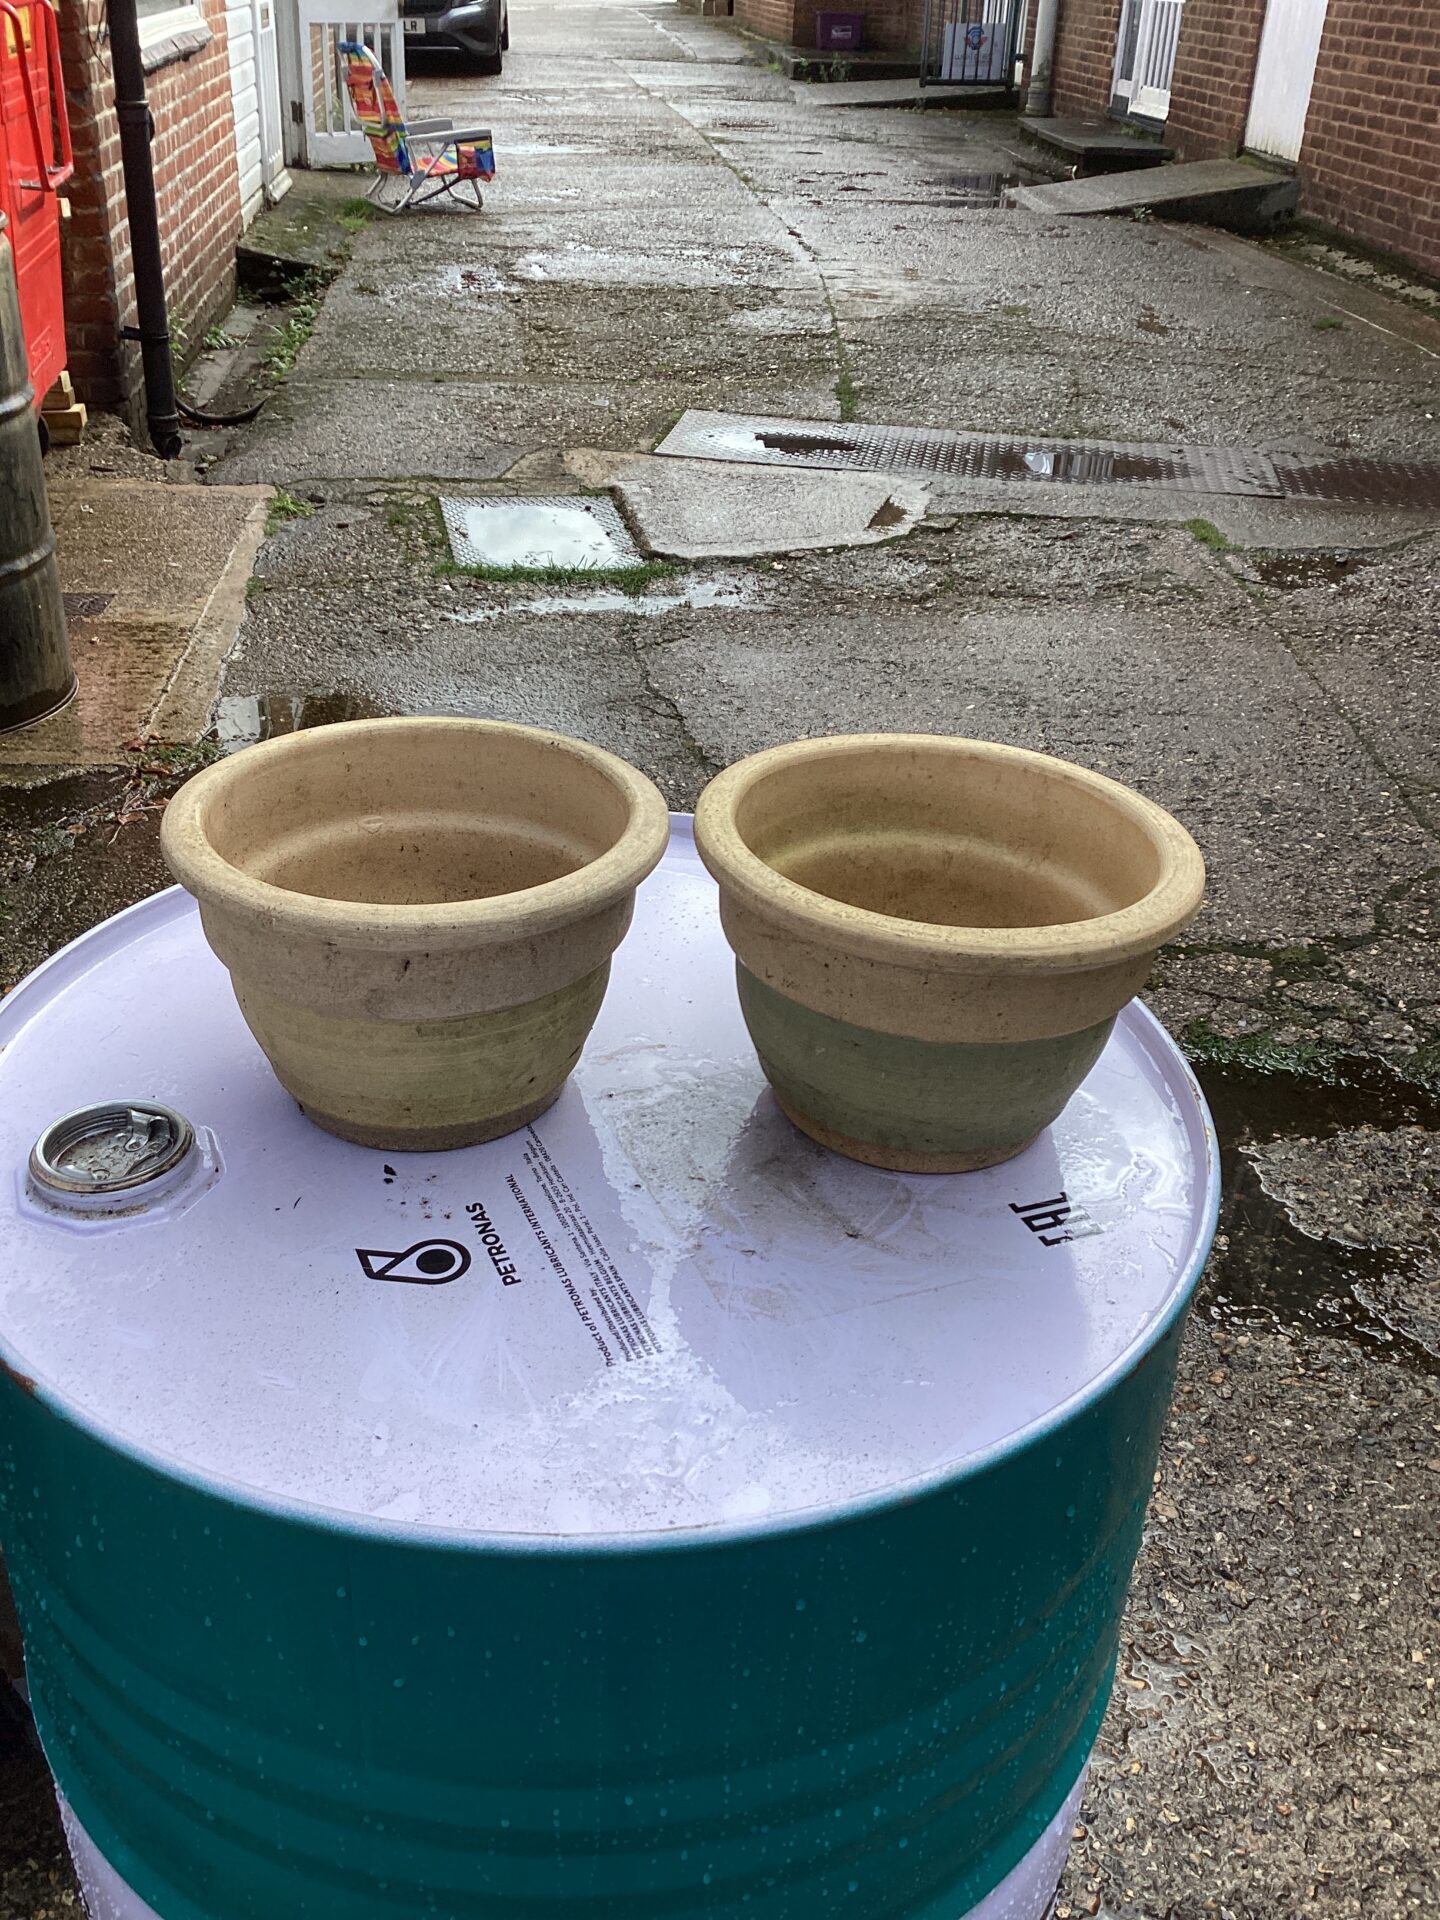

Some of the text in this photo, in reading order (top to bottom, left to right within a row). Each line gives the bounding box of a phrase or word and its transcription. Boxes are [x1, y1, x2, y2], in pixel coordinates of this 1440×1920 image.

[465, 1202, 522, 1286] PETRONAS
[504, 1173, 616, 1367] Product of PETRONAS LUBRICANTS INTERNATIONAL
[588, 1271, 603, 1287] ITALY
[593, 1258, 613, 1285] BELGIUM
[607, 1264, 623, 1282] SPAIN
[598, 1287, 624, 1325] LUBRICANTS
[608, 1284, 634, 1322] LUBRICANTS
[617, 1282, 645, 1319] LUBRICANTS
[592, 1296, 633, 1362] Produced/Distributed
[619, 1325, 643, 1359] PETRONAS
[629, 1322, 653, 1356] PETRONAS
[639, 1319, 664, 1353] PETRONAS
